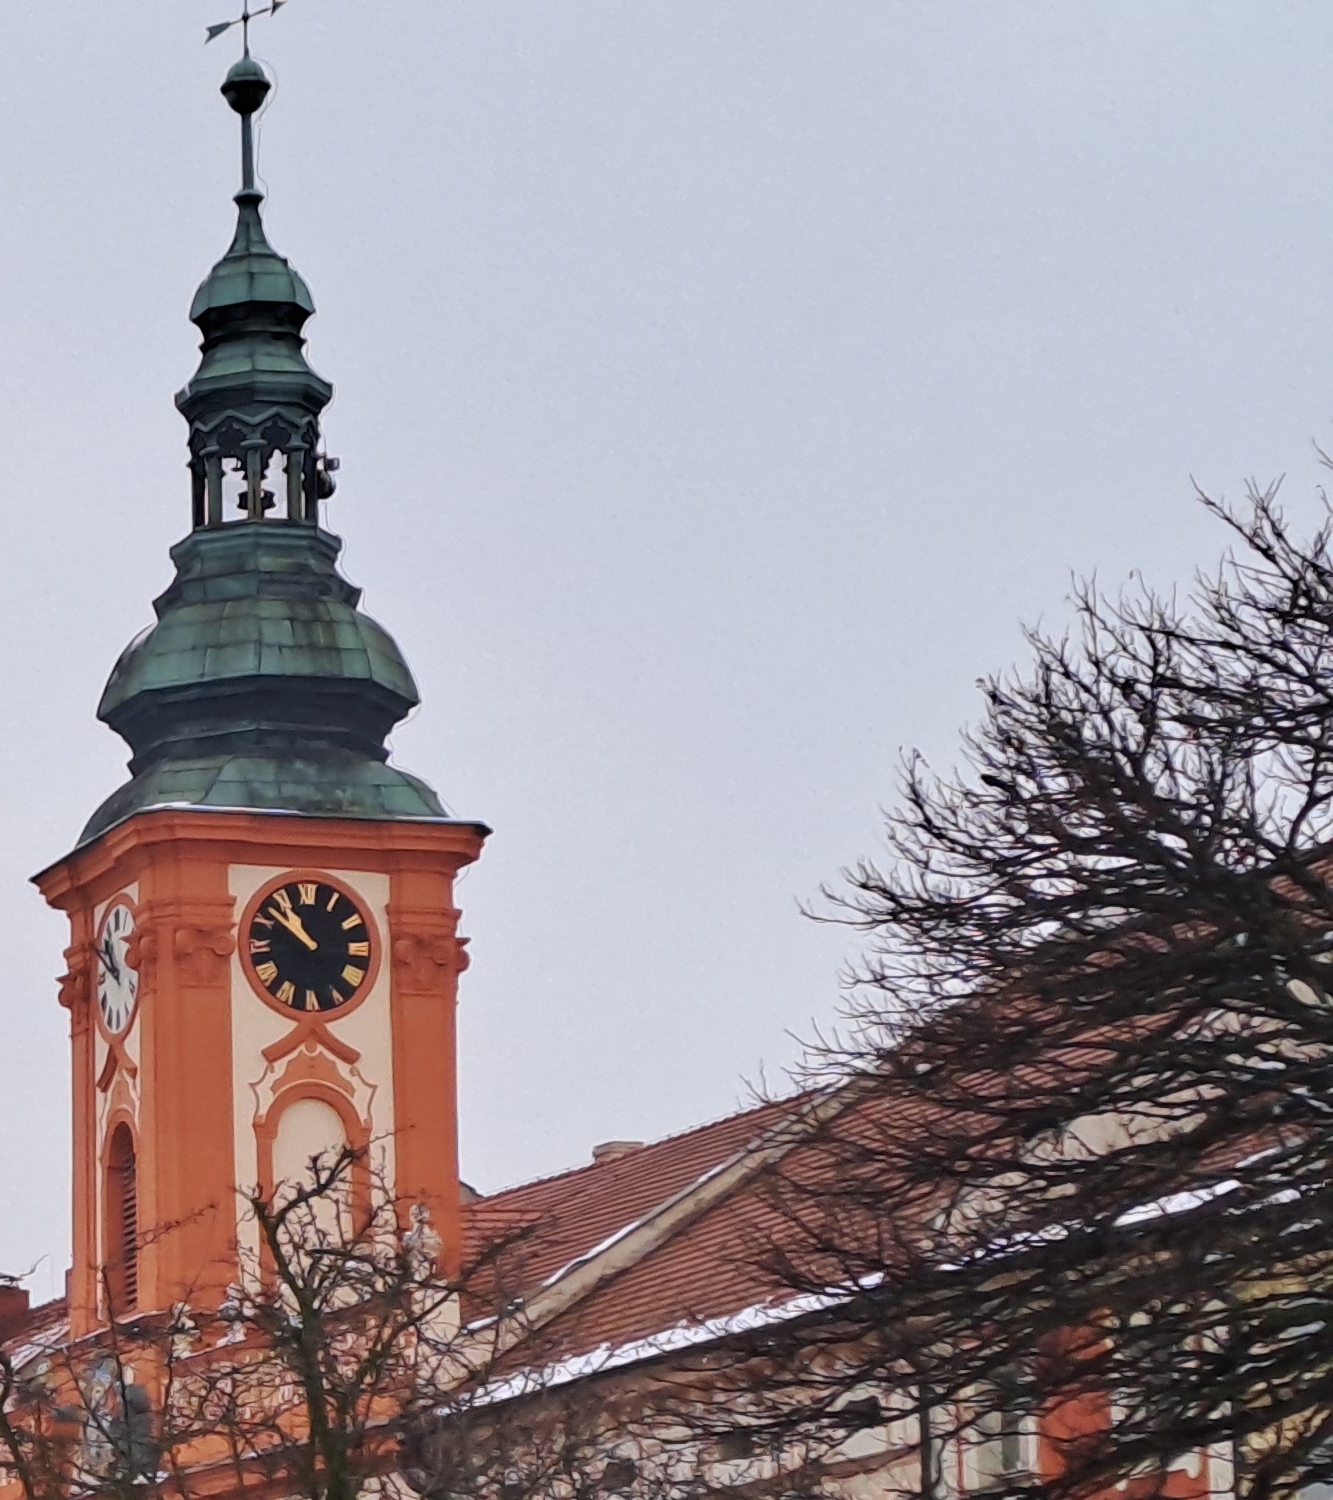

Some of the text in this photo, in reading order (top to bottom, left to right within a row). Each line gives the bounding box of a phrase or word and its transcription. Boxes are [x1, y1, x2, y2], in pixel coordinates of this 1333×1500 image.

[298, 883, 318, 905] XII
[327, 892, 339, 912] I
[341, 913, 363, 931] II
[347, 941, 370, 957] III
